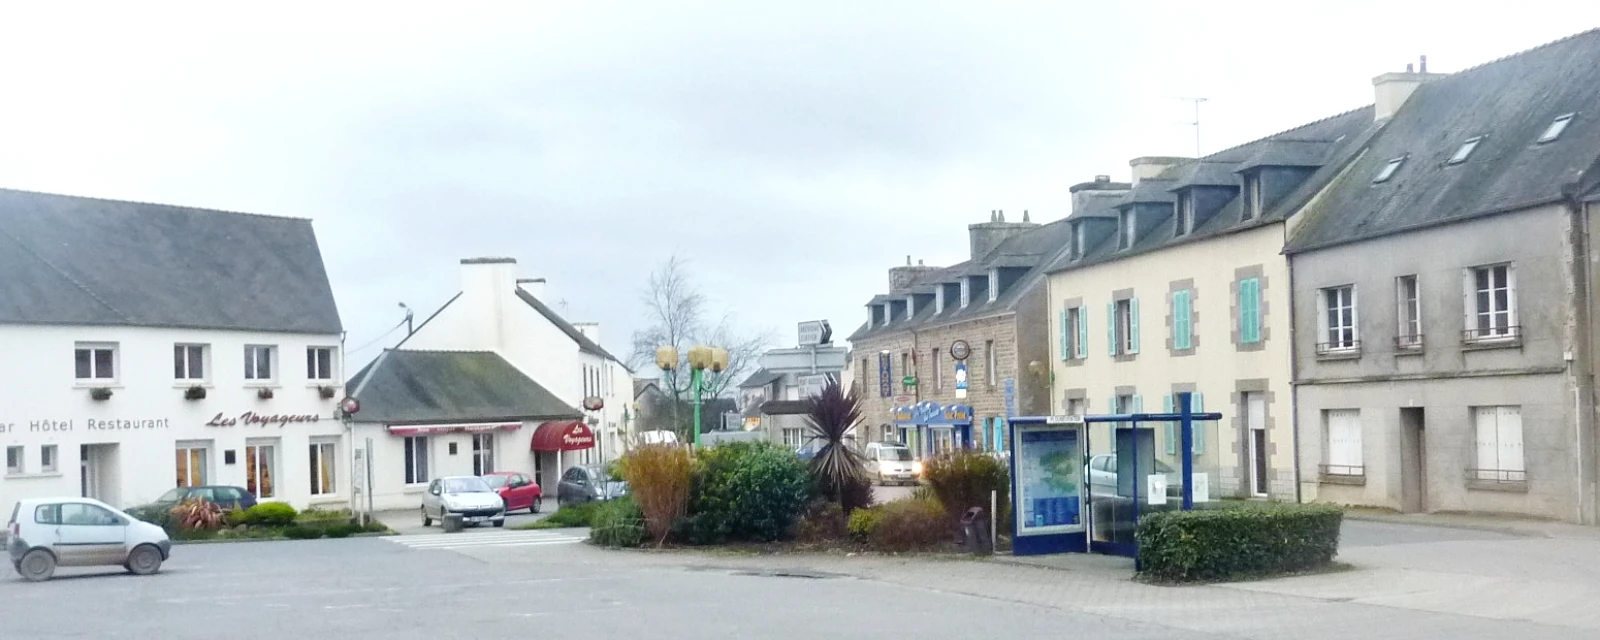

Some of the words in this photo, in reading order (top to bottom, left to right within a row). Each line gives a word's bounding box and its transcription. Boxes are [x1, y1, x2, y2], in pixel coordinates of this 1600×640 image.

[30, 419, 74, 432] Hôtel
[87, 417, 170, 430] Restaurant
[206, 411, 237, 427] Les
[240, 410, 320, 428] Voyageurs
